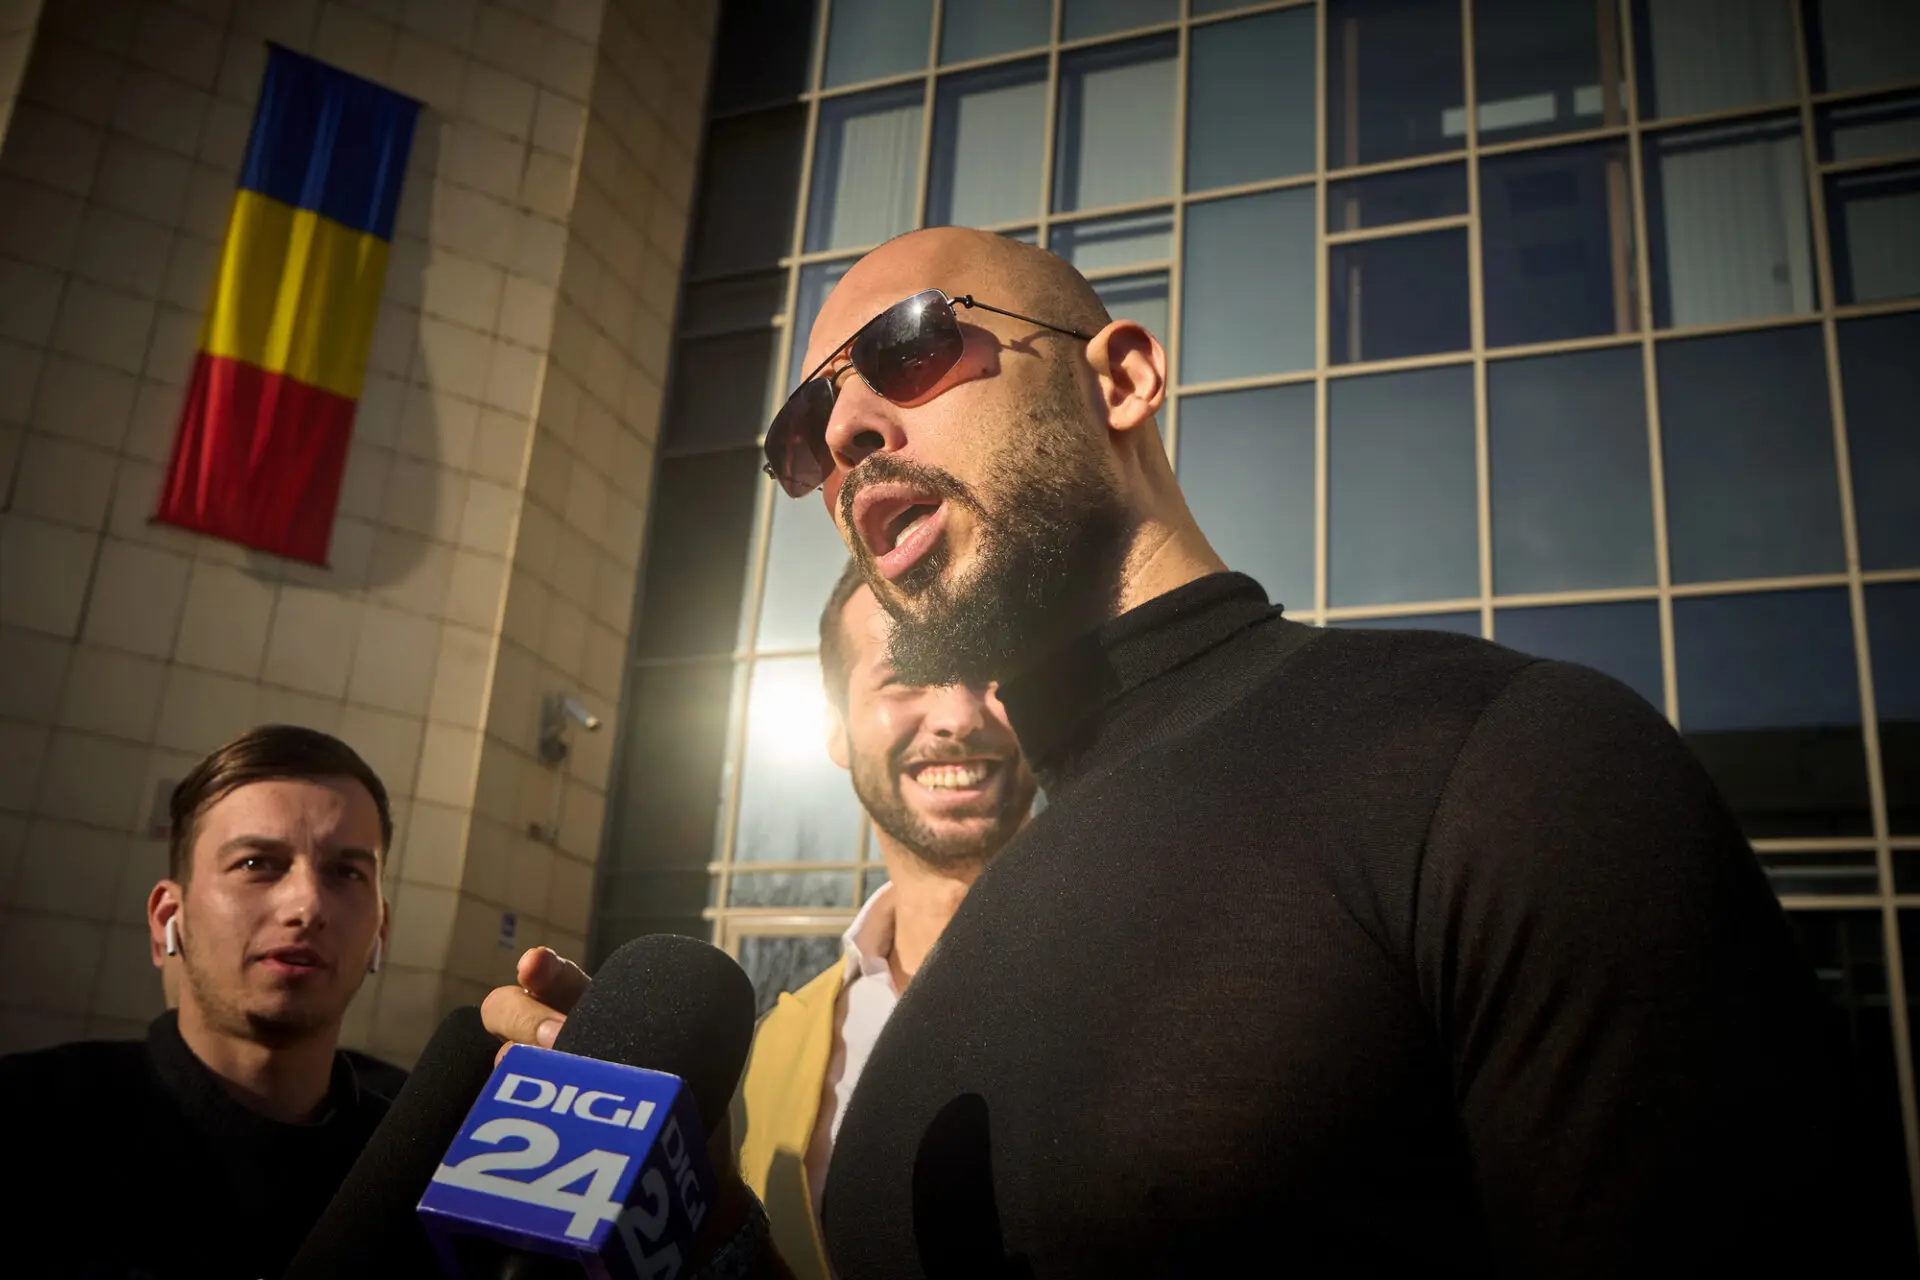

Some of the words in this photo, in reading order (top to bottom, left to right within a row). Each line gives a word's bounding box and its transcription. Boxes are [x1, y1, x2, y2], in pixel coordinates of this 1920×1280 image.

[494, 1073, 656, 1130] DIGI
[432, 1117, 631, 1240] 24
[660, 1115, 707, 1232] DIGI
